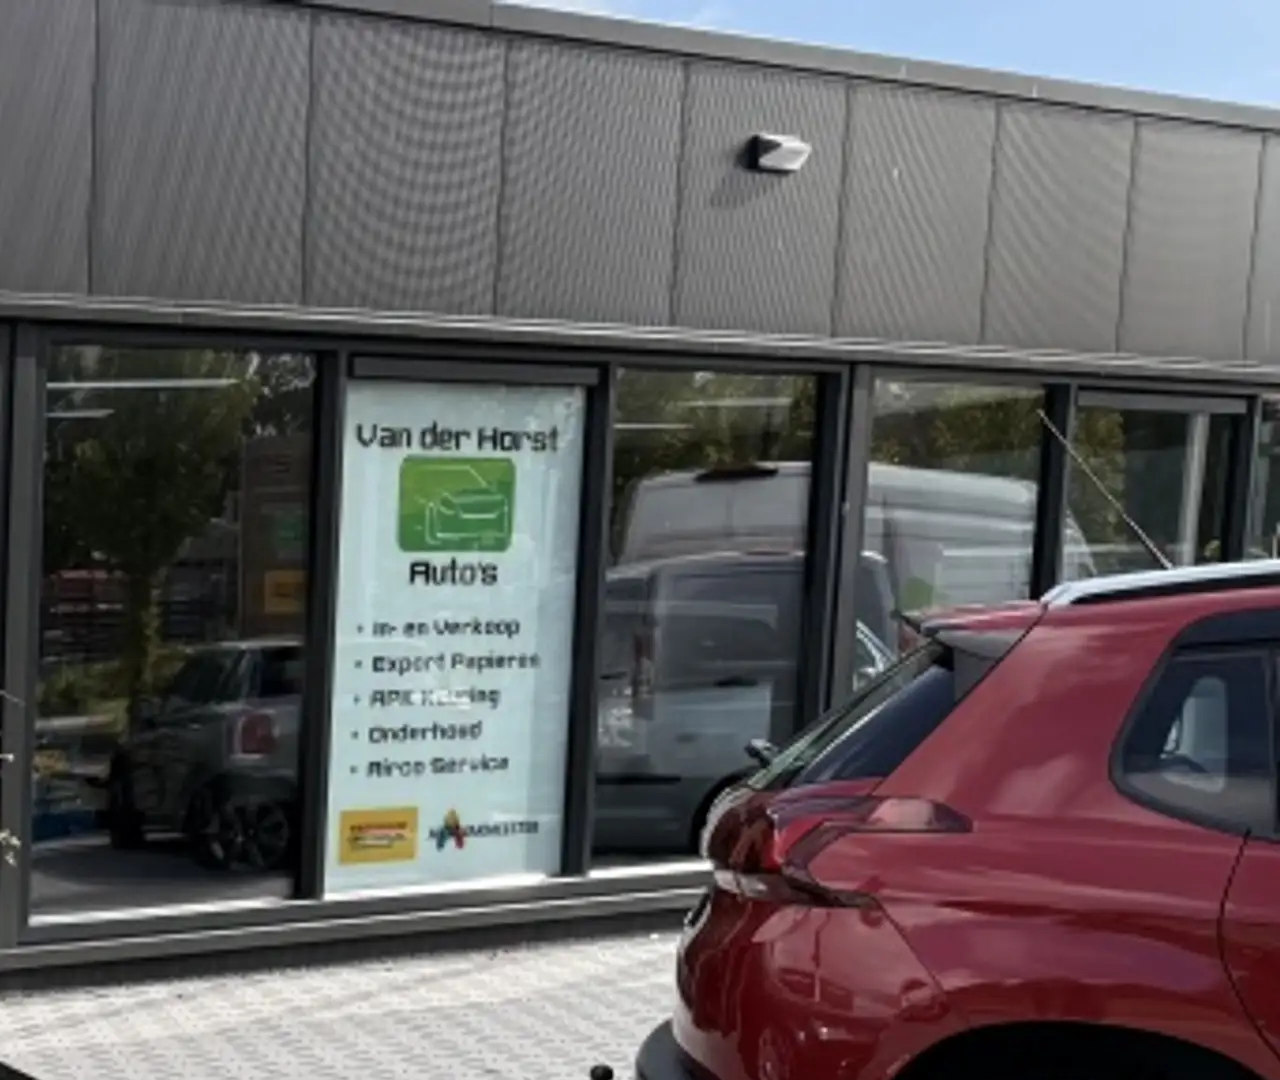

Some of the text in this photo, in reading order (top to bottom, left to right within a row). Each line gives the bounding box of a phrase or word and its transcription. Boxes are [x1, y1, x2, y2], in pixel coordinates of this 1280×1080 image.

[356, 420, 560, 453] Van der Horst
[409, 557, 498, 586] Auto's
[403, 621, 430, 638] en
